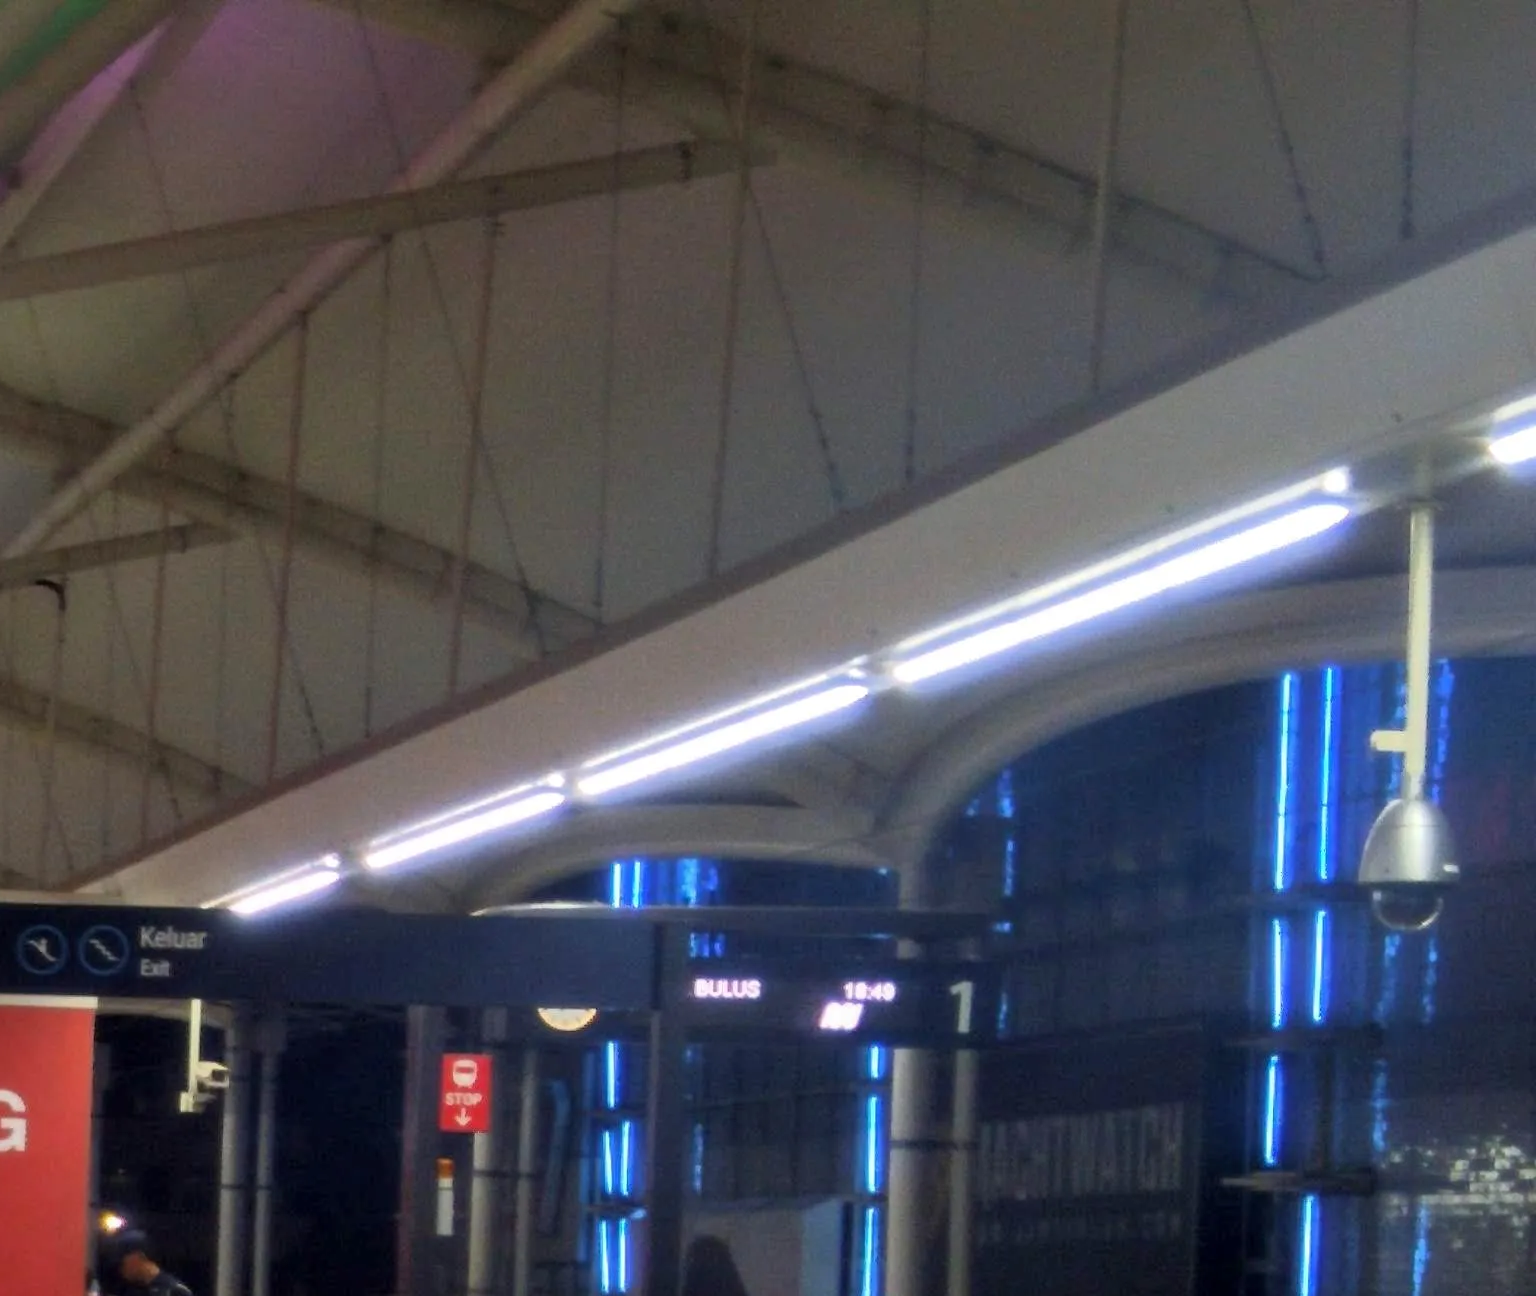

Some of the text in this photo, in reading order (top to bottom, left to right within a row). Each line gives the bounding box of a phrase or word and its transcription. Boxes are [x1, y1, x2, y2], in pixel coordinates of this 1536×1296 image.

[140, 926, 207, 949] Keluar
[140, 958, 170, 977] Exit
[693, 978, 762, 998] BULUS
[950, 981, 973, 1033] 1
[445, 1092, 483, 1106] STOP
